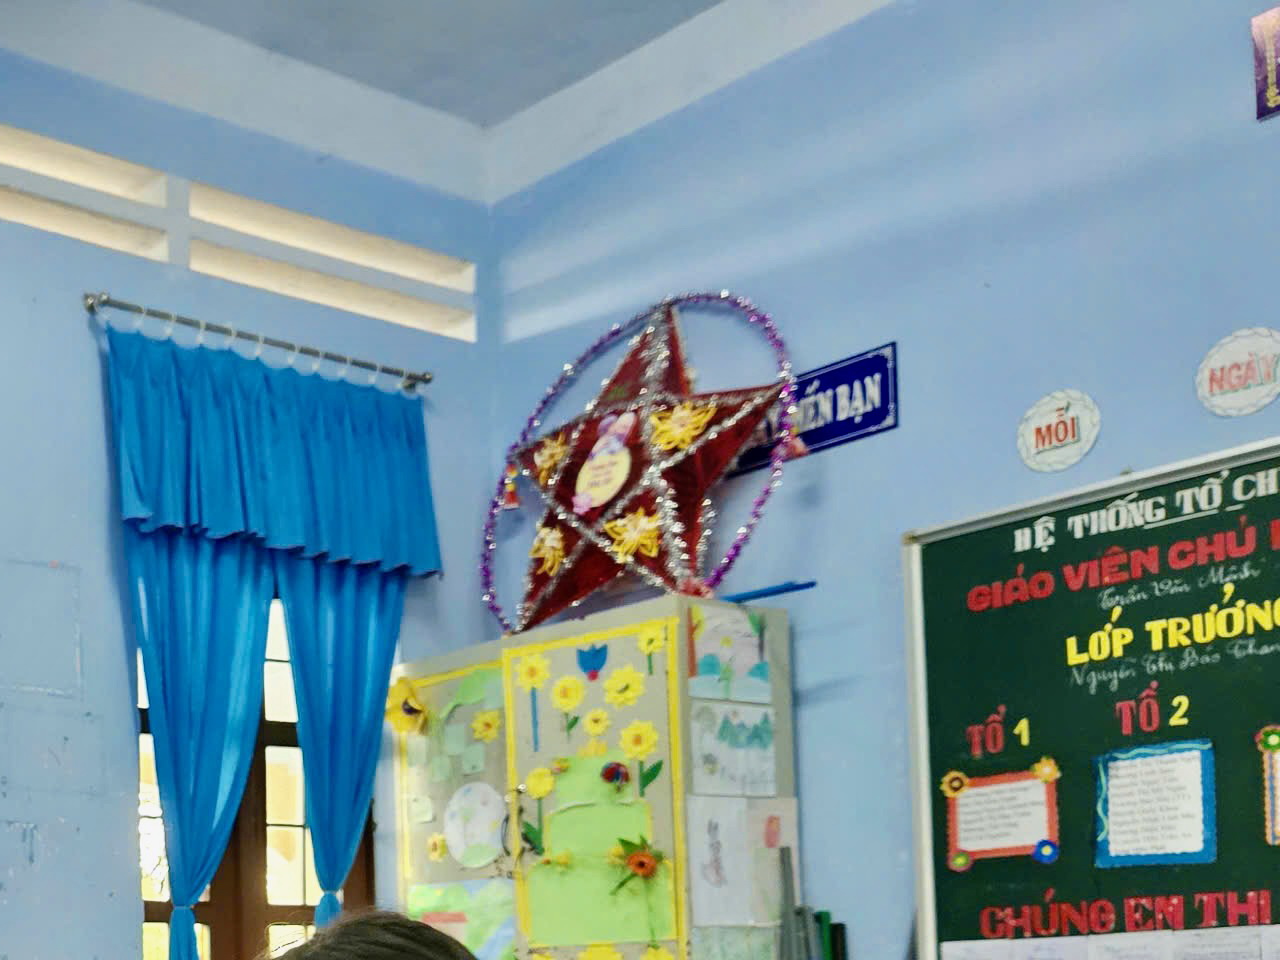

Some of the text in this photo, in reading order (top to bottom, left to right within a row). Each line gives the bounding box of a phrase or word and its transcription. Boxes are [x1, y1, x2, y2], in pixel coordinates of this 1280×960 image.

[835, 372, 882, 424] BẠN
[1067, 491, 1166, 539] THỐNG
[1175, 469, 1230, 515] TỔ
[967, 562, 1055, 613] GIÁO
[1062, 546, 1160, 592] VIÊN
[1167, 514, 1257, 571] CHỦ
[1066, 605, 1134, 667] LỚP
[966, 704, 1031, 760] TỔ 1
[1114, 680, 1190, 736] TỔ 2
[979, 887, 1116, 939] CHÚNG
[1193, 889, 1272, 929] THI
